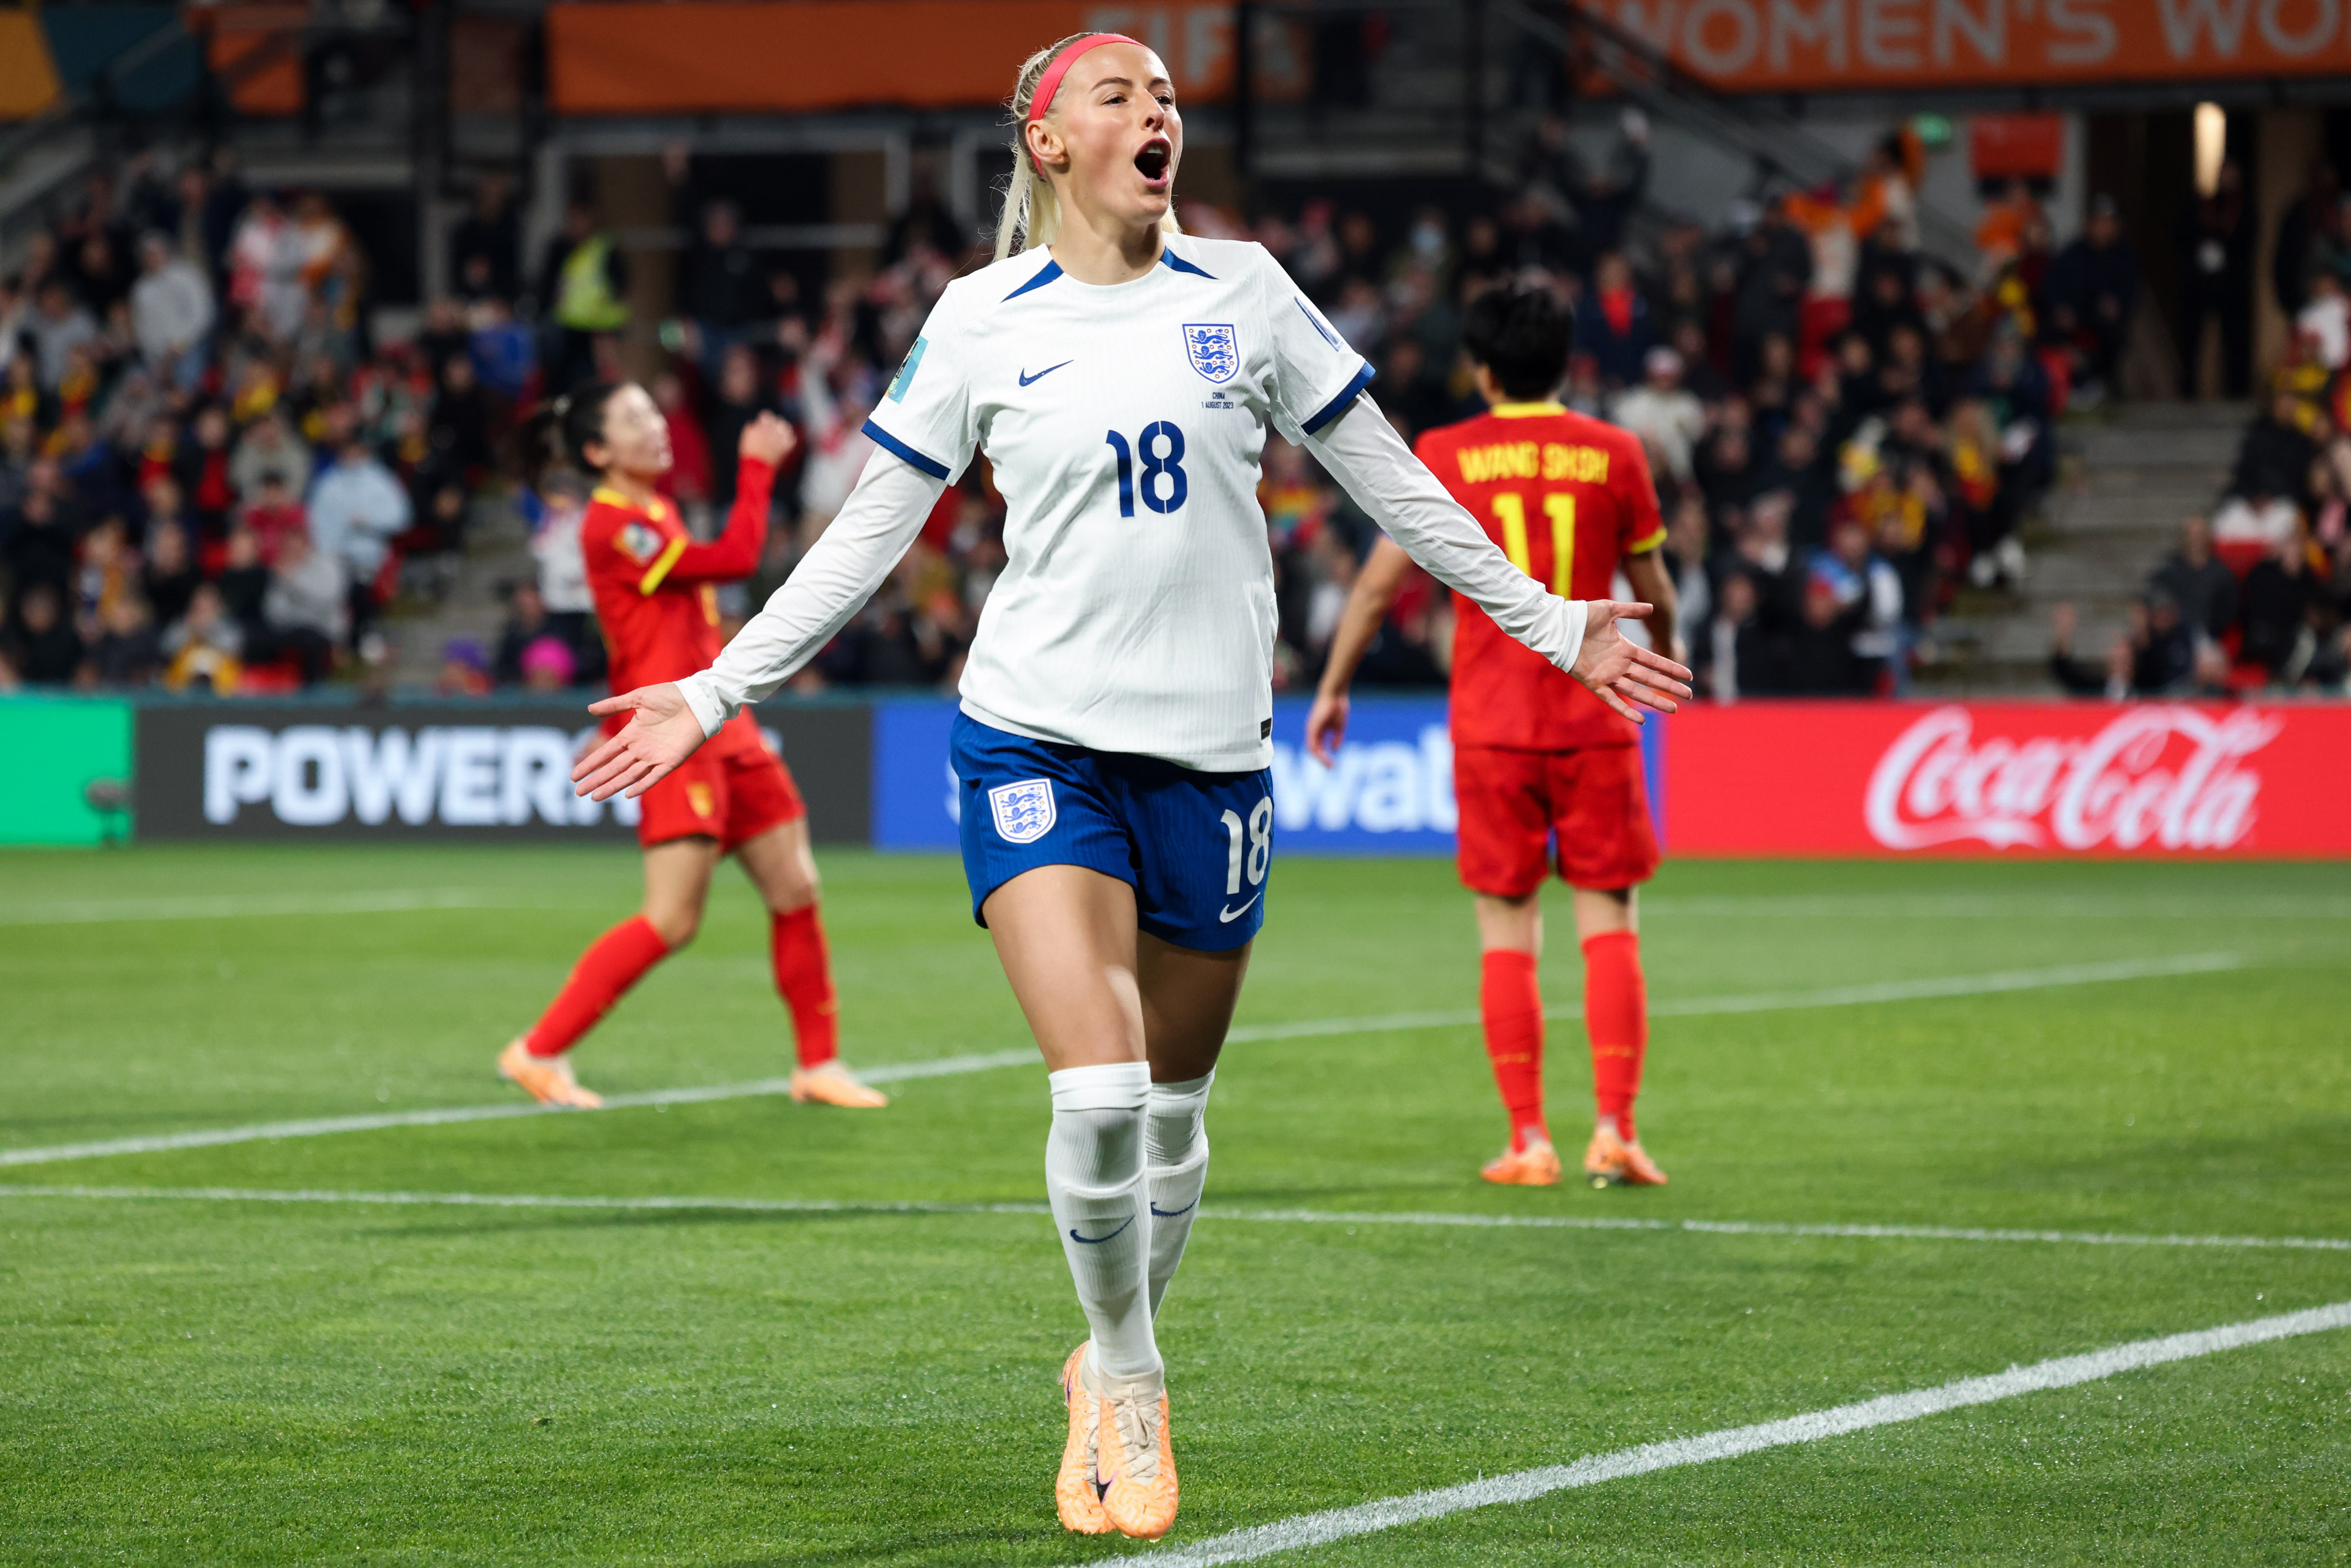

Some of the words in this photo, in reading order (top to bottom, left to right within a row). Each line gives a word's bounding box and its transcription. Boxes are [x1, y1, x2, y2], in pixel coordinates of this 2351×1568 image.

[2154, 0, 2351, 57] WO
[1106, 420, 1188, 518] 18
[1456, 440, 1539, 485] WANG
[1491, 491, 1576, 602] 11
[1864, 705, 2284, 850] Coca-Cola
[1220, 796, 1273, 895] 18
